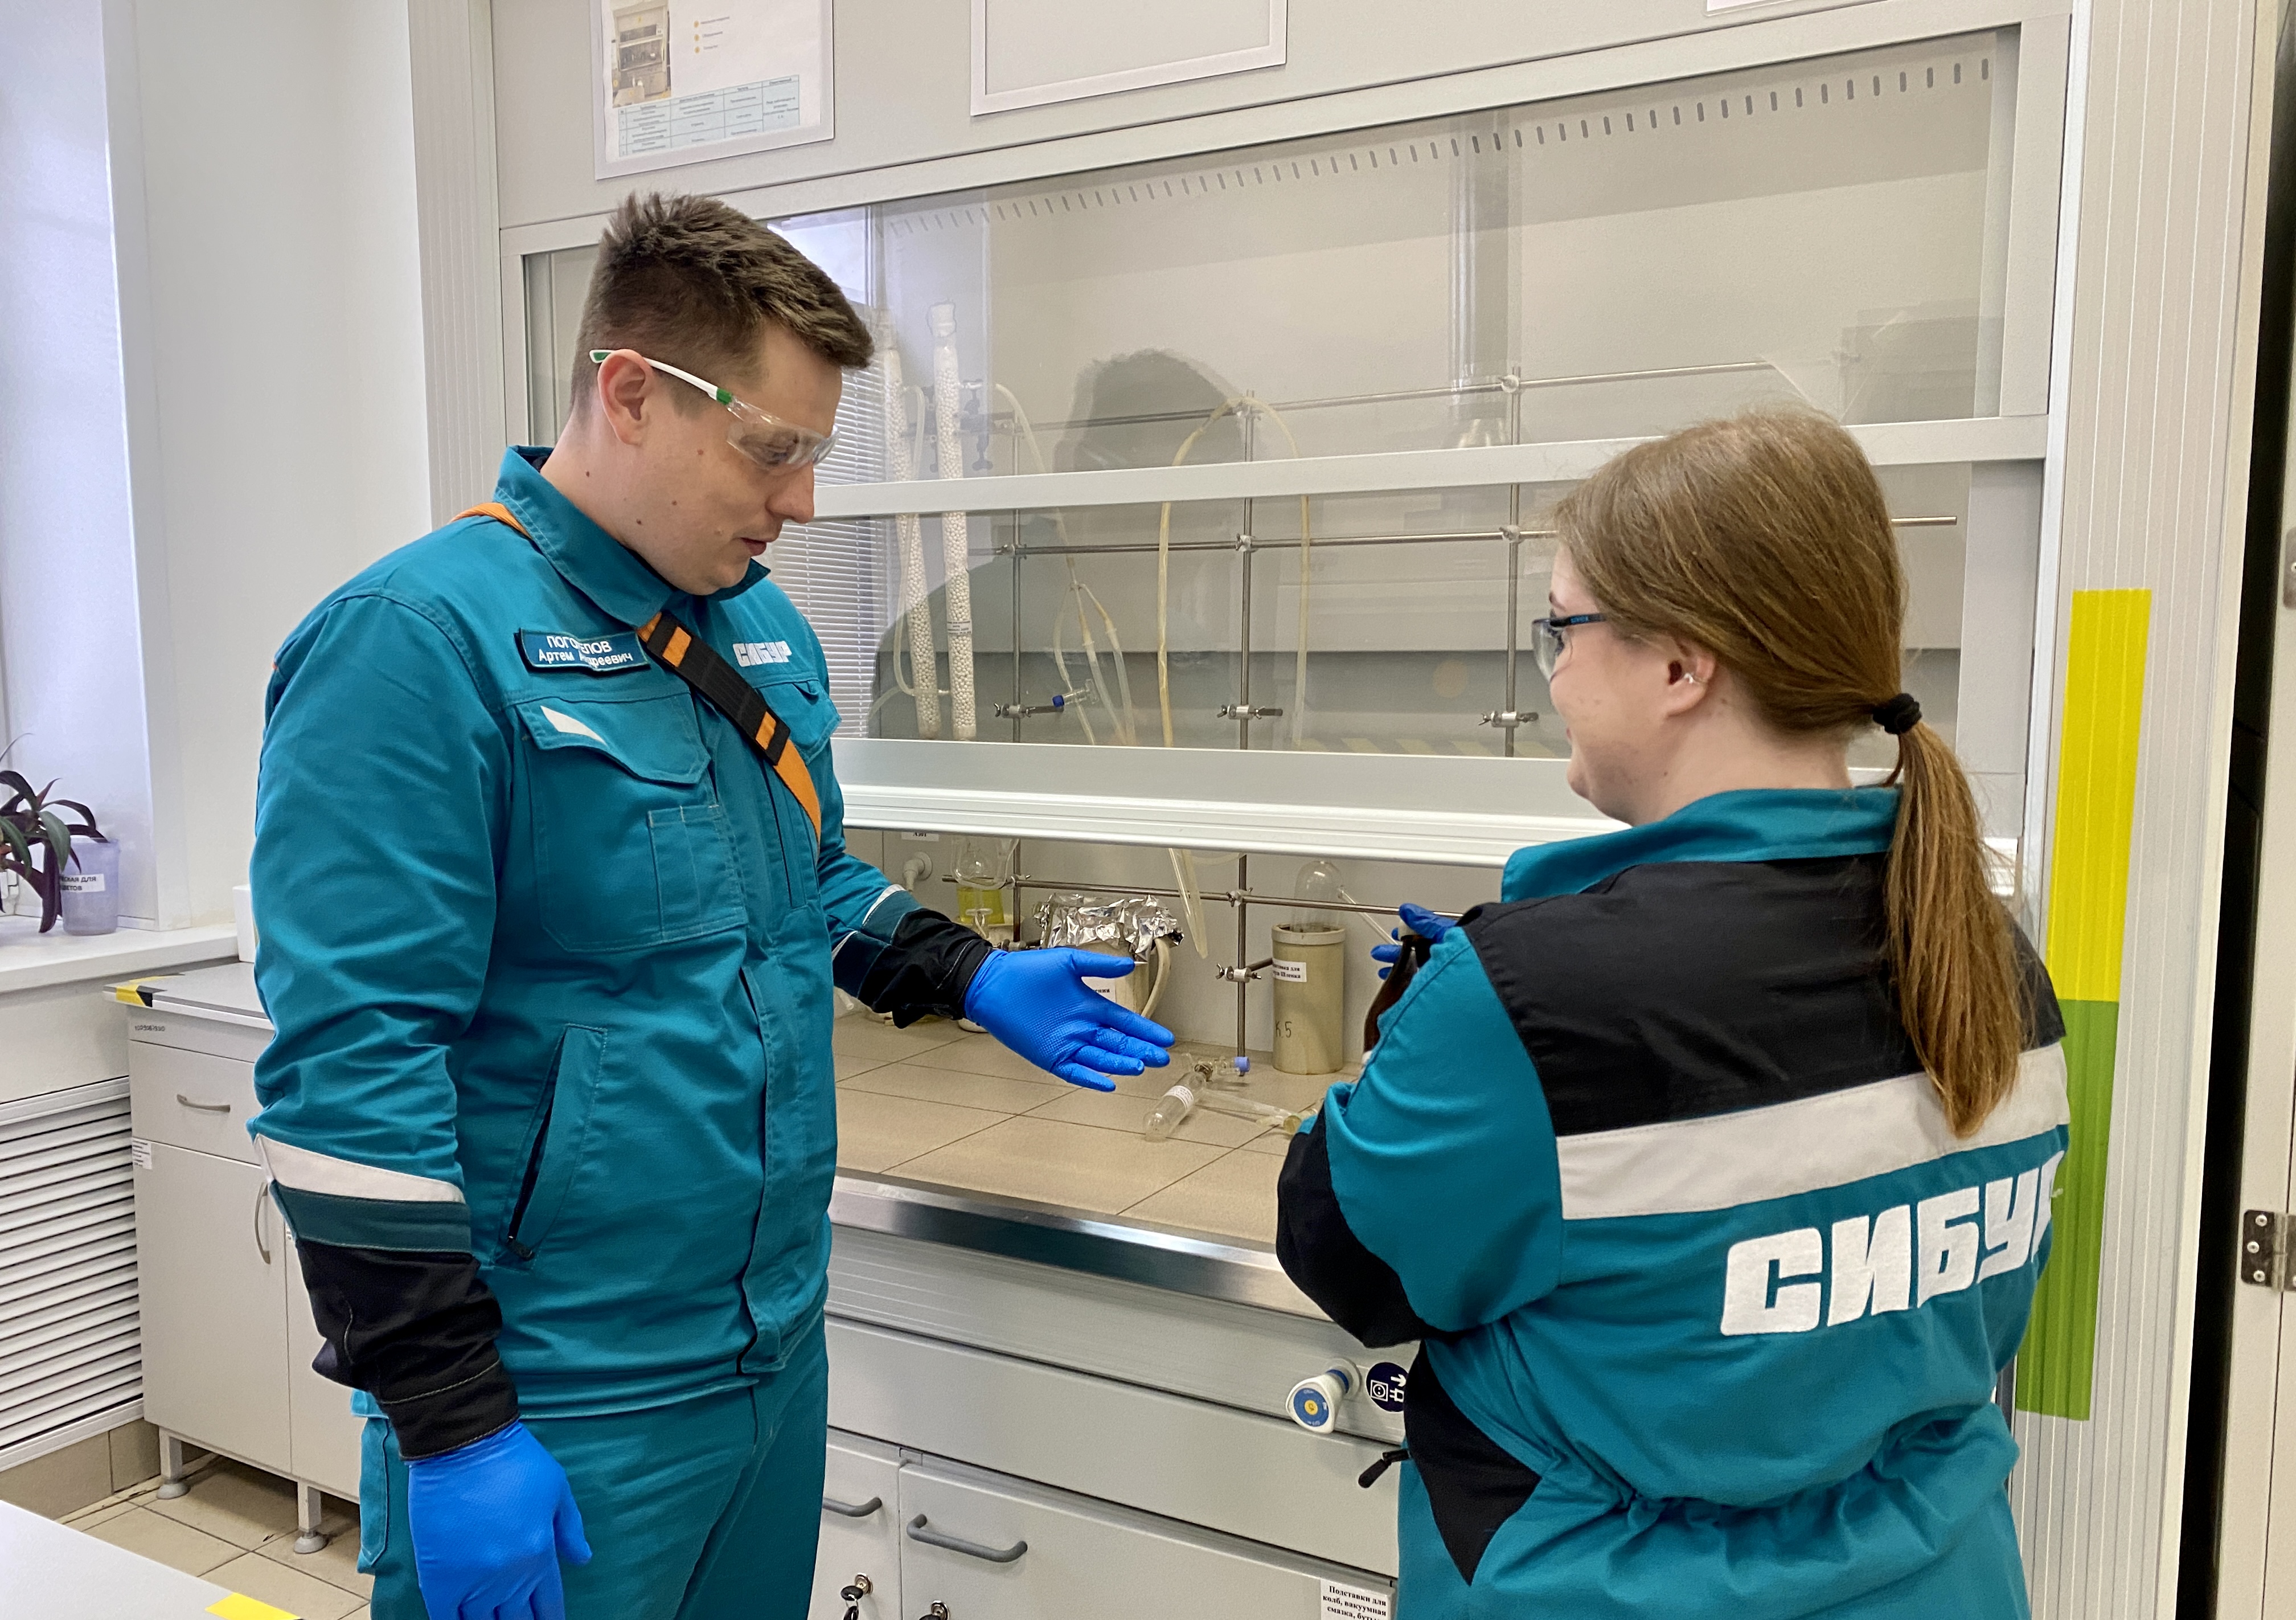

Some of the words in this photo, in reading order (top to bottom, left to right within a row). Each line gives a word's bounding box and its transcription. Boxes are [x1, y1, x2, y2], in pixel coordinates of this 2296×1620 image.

[546, 636, 612, 654] ПОГОЕЛОВ
[732, 640, 792, 667] СИБУР
[539, 649, 575, 664] Артем
[1329, 1585, 1370, 1602] Подставки
[1372, 1598, 1386, 1606] для
[1323, 1596, 1343, 1606] колб,
[1344, 1601, 1386, 1617] вакуумная
[1327, 1606, 1355, 1619] смазка,
